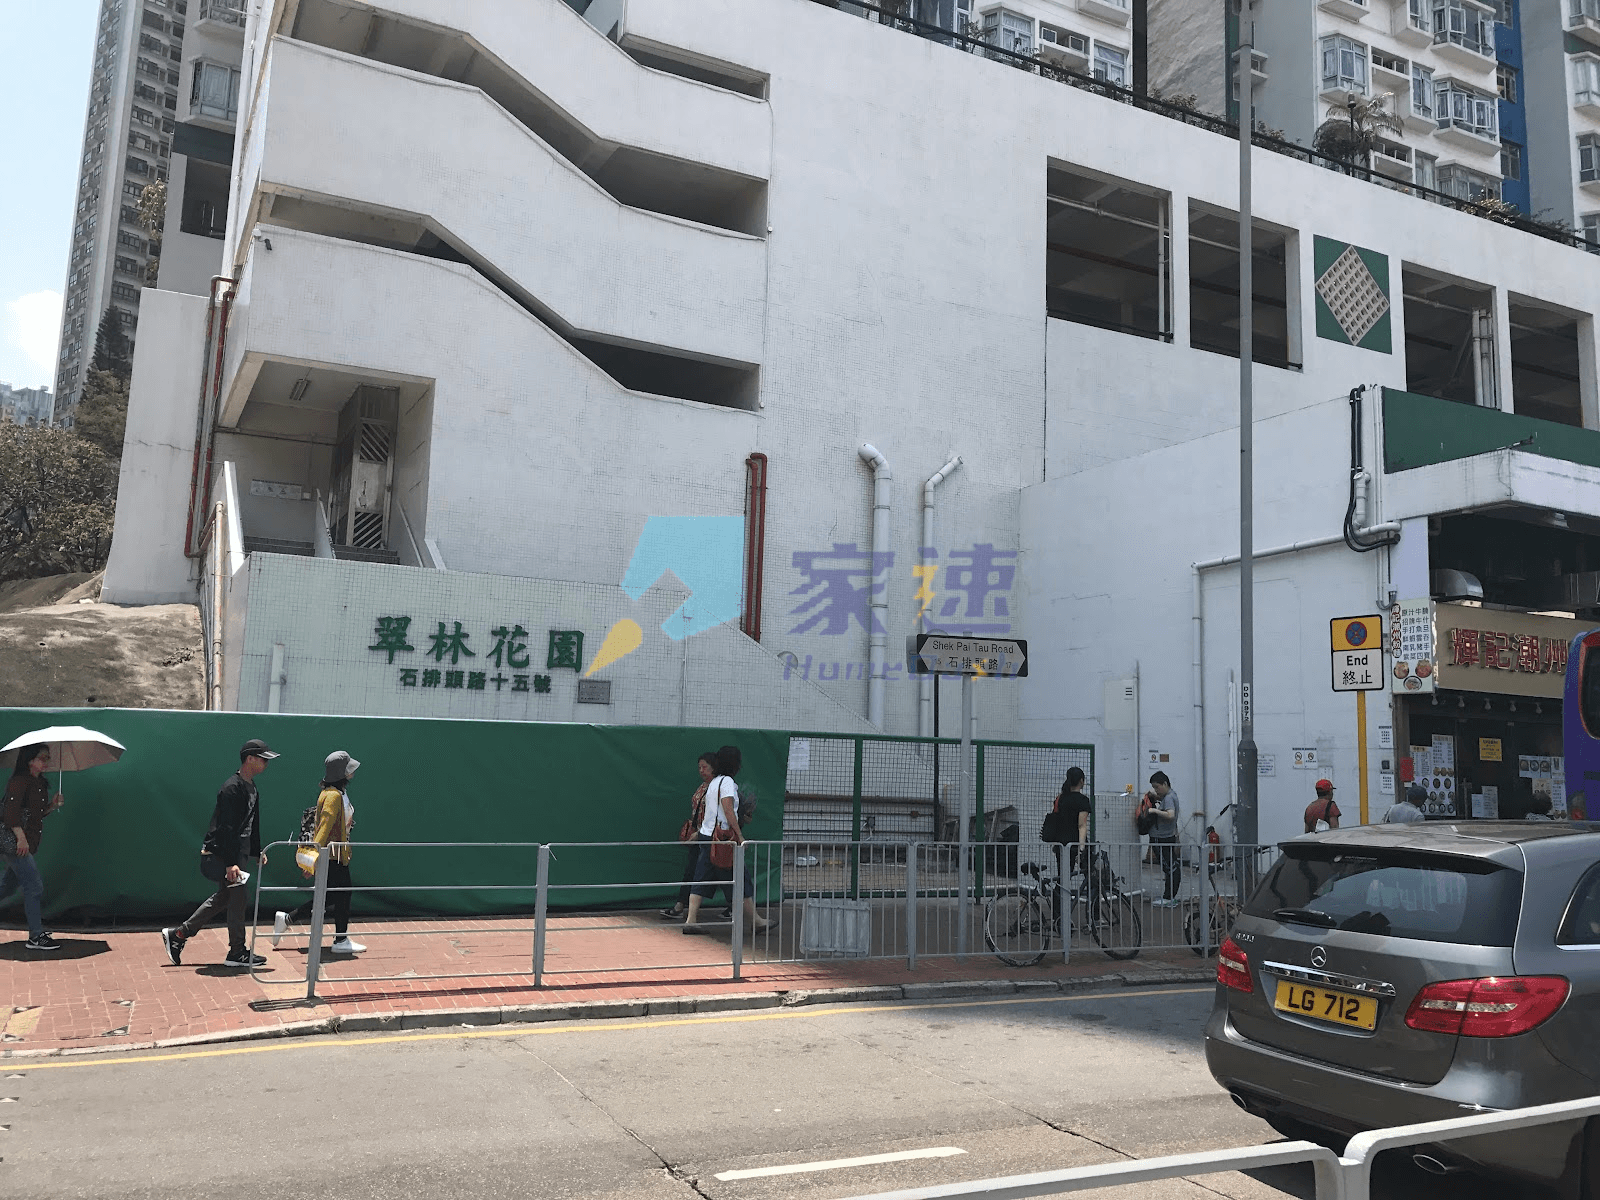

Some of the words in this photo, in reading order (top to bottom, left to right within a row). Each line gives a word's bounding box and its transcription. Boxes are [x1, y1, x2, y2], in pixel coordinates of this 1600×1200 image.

[368, 616, 585, 673] 翠林花園
[933, 640, 954, 651] Shek
[957, 642, 971, 651] Pai
[973, 643, 989, 653] Tau
[991, 644, 1014, 654] Road
[949, 656, 998, 670] 石排頭路
[1347, 655, 1368, 666] End
[399, 668, 552, 693] 石排頭路十五號
[1342, 669, 1373, 685] 終止
[1288, 986, 1315, 1012] LG
[1324, 993, 1360, 1021] 712
